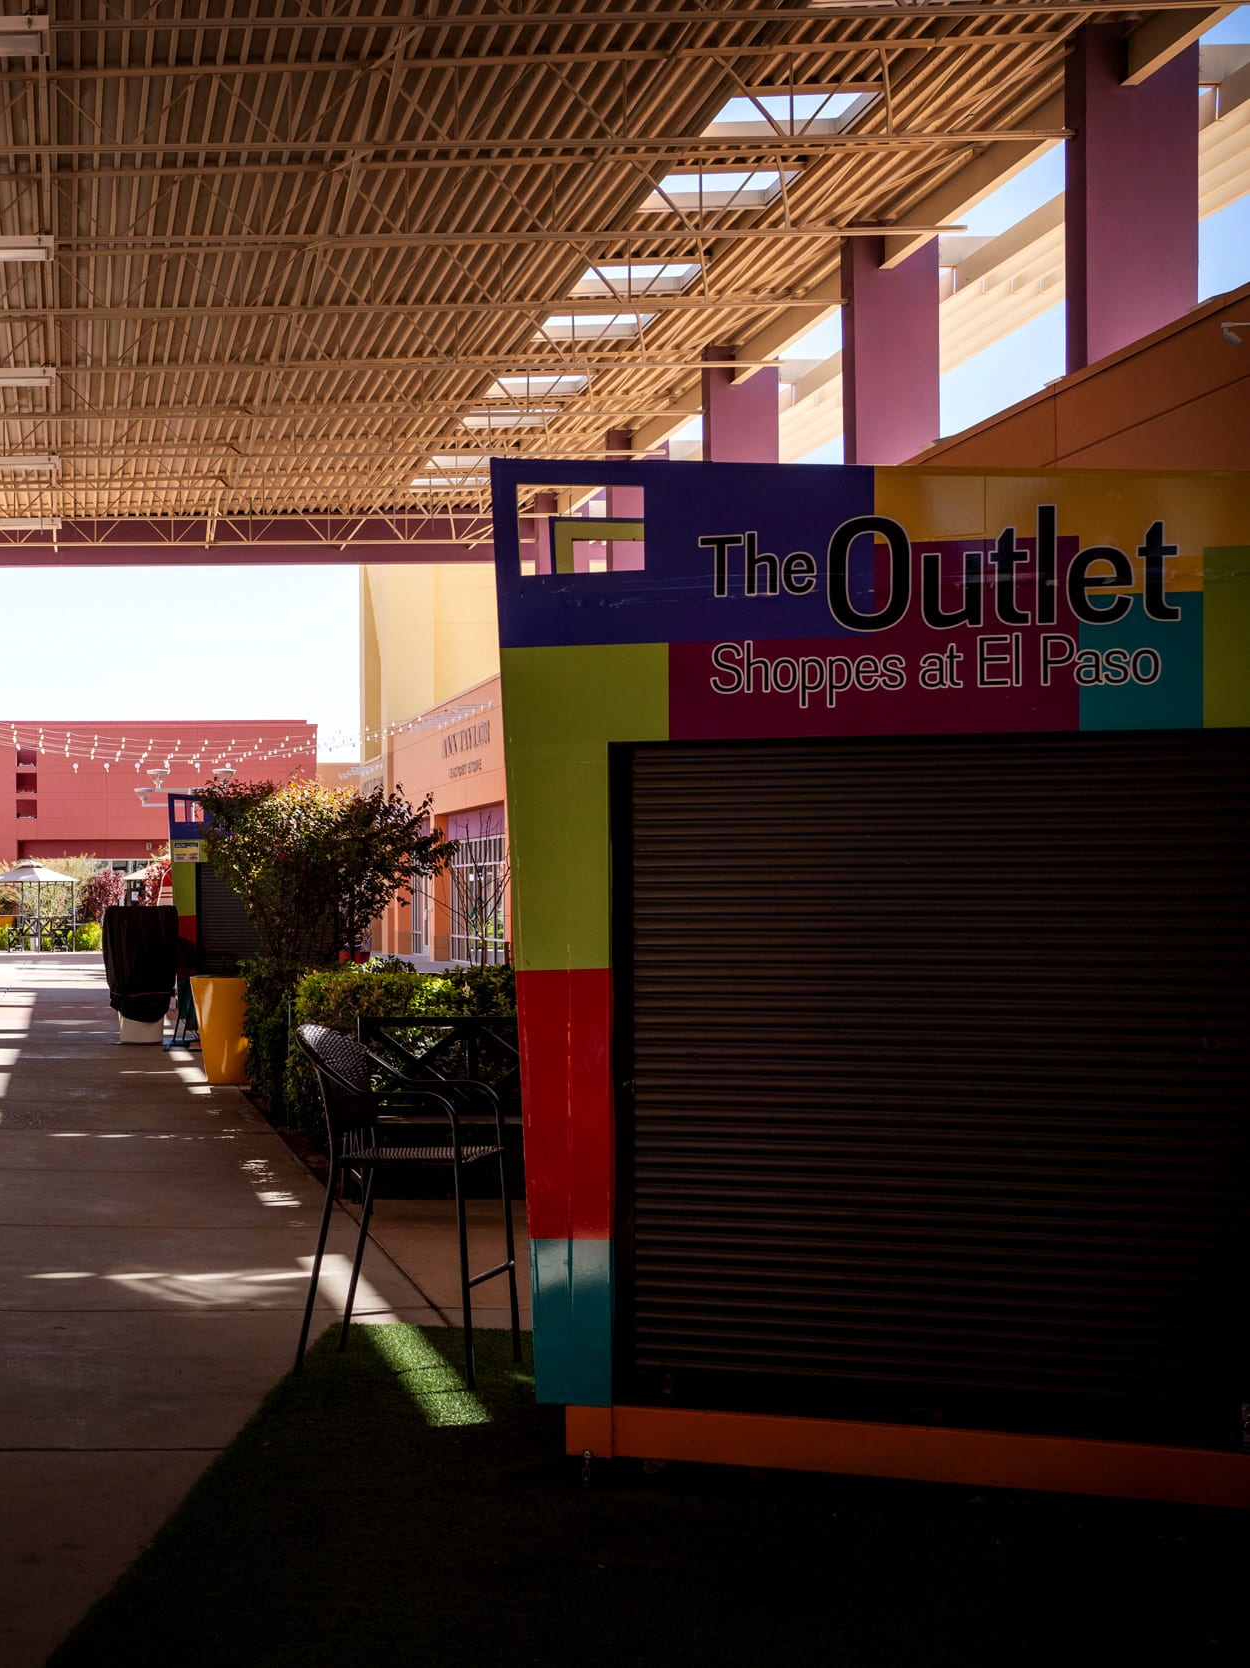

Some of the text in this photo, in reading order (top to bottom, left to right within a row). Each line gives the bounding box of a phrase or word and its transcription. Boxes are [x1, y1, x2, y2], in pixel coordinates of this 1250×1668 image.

[698, 504, 1182, 632] The Outlet
[711, 633, 1162, 708] Shoppes at El Paso
